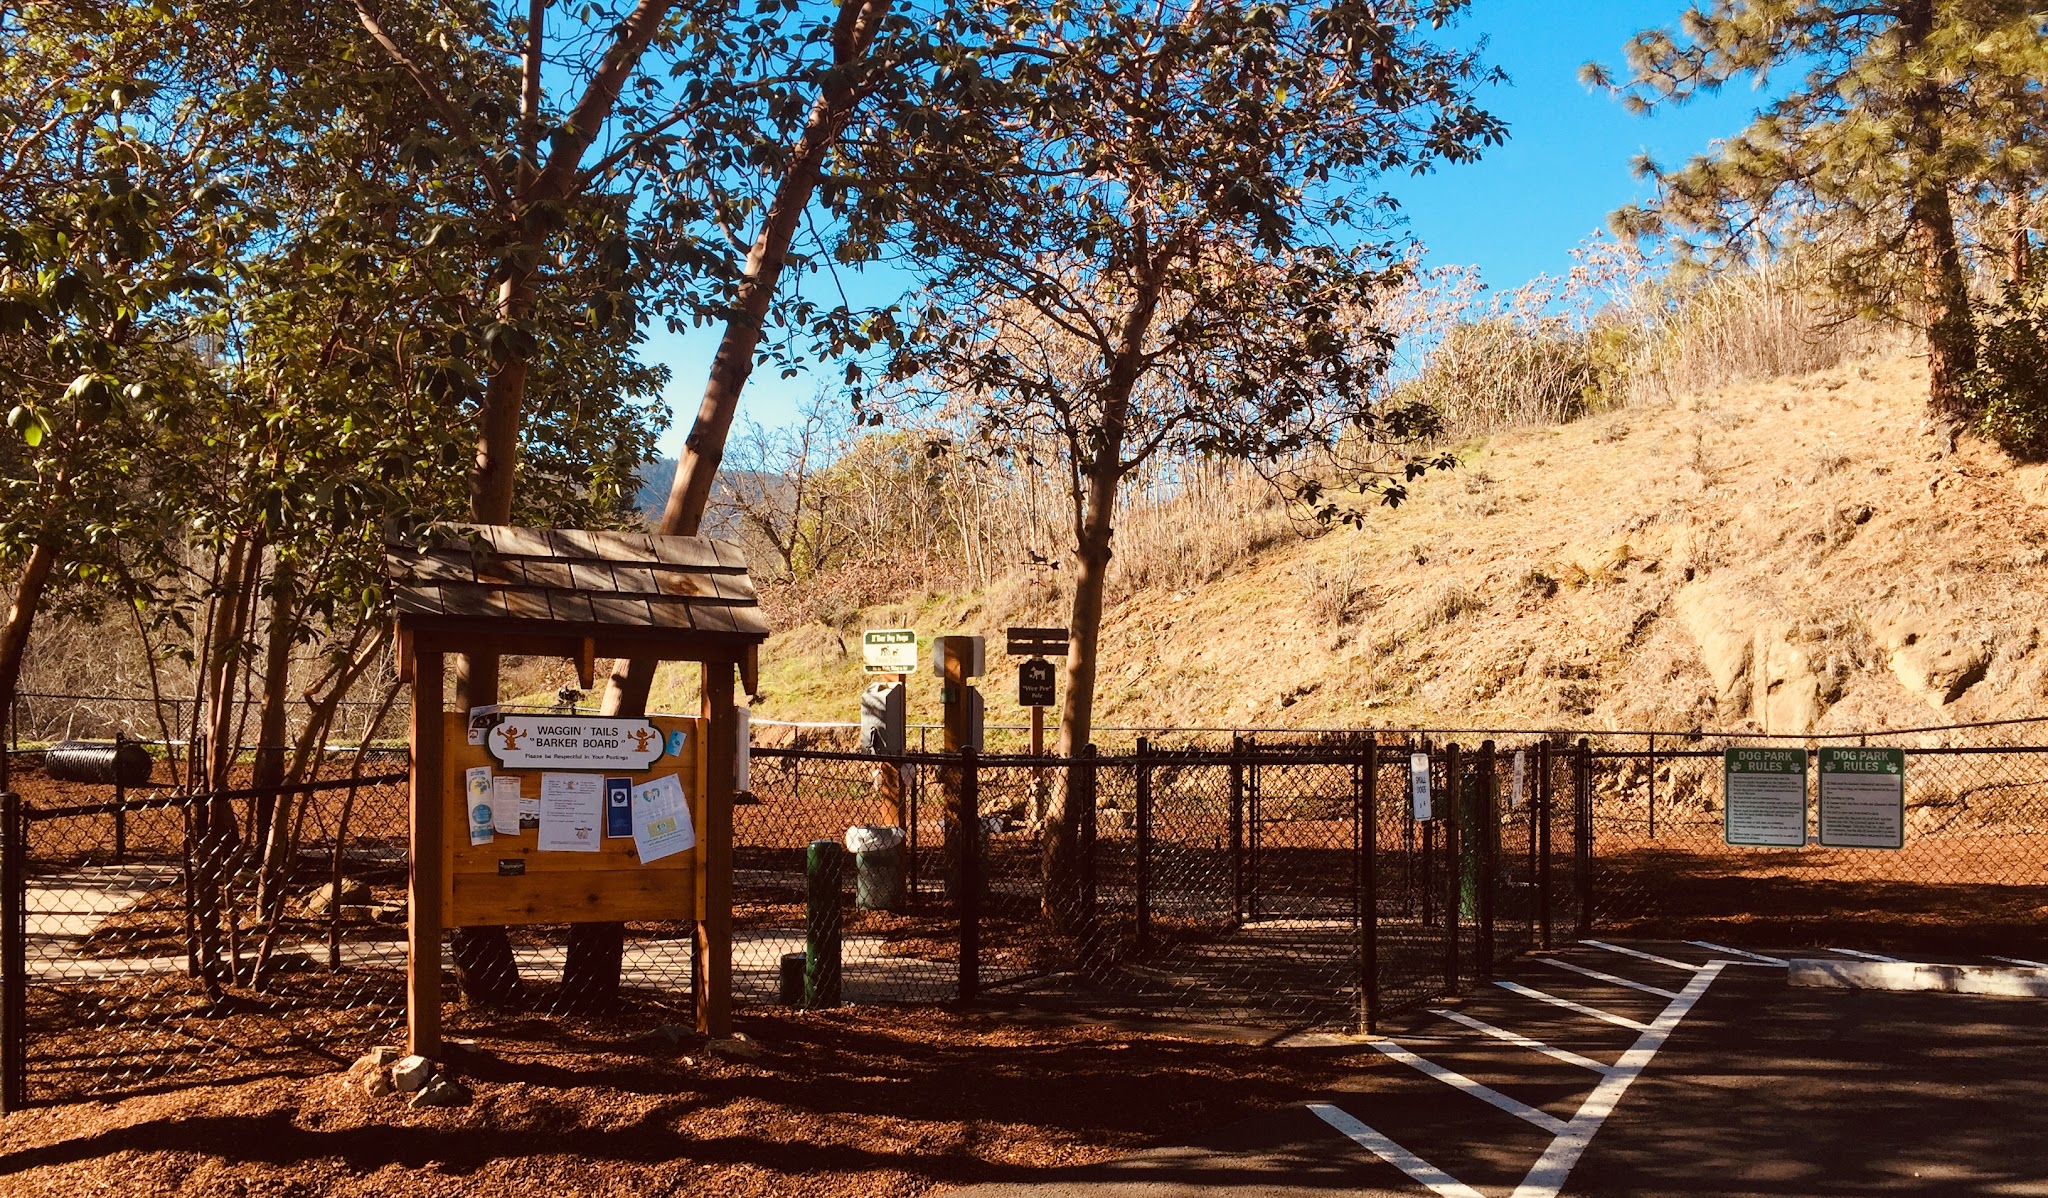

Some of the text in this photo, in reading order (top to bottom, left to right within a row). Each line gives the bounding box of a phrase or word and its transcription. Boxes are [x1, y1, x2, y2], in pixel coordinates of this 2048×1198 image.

[590, 727, 619, 737] TAILS
[529, 738, 626, 749] "BARKER BOARD"
[553, 753, 582, 761] Respectful
[1739, 751, 1792, 761] DOG PARK
[1833, 751, 1889, 760] DOG PARK
[1748, 762, 1783, 771] RULES
[1843, 762, 1879, 771] RULES
